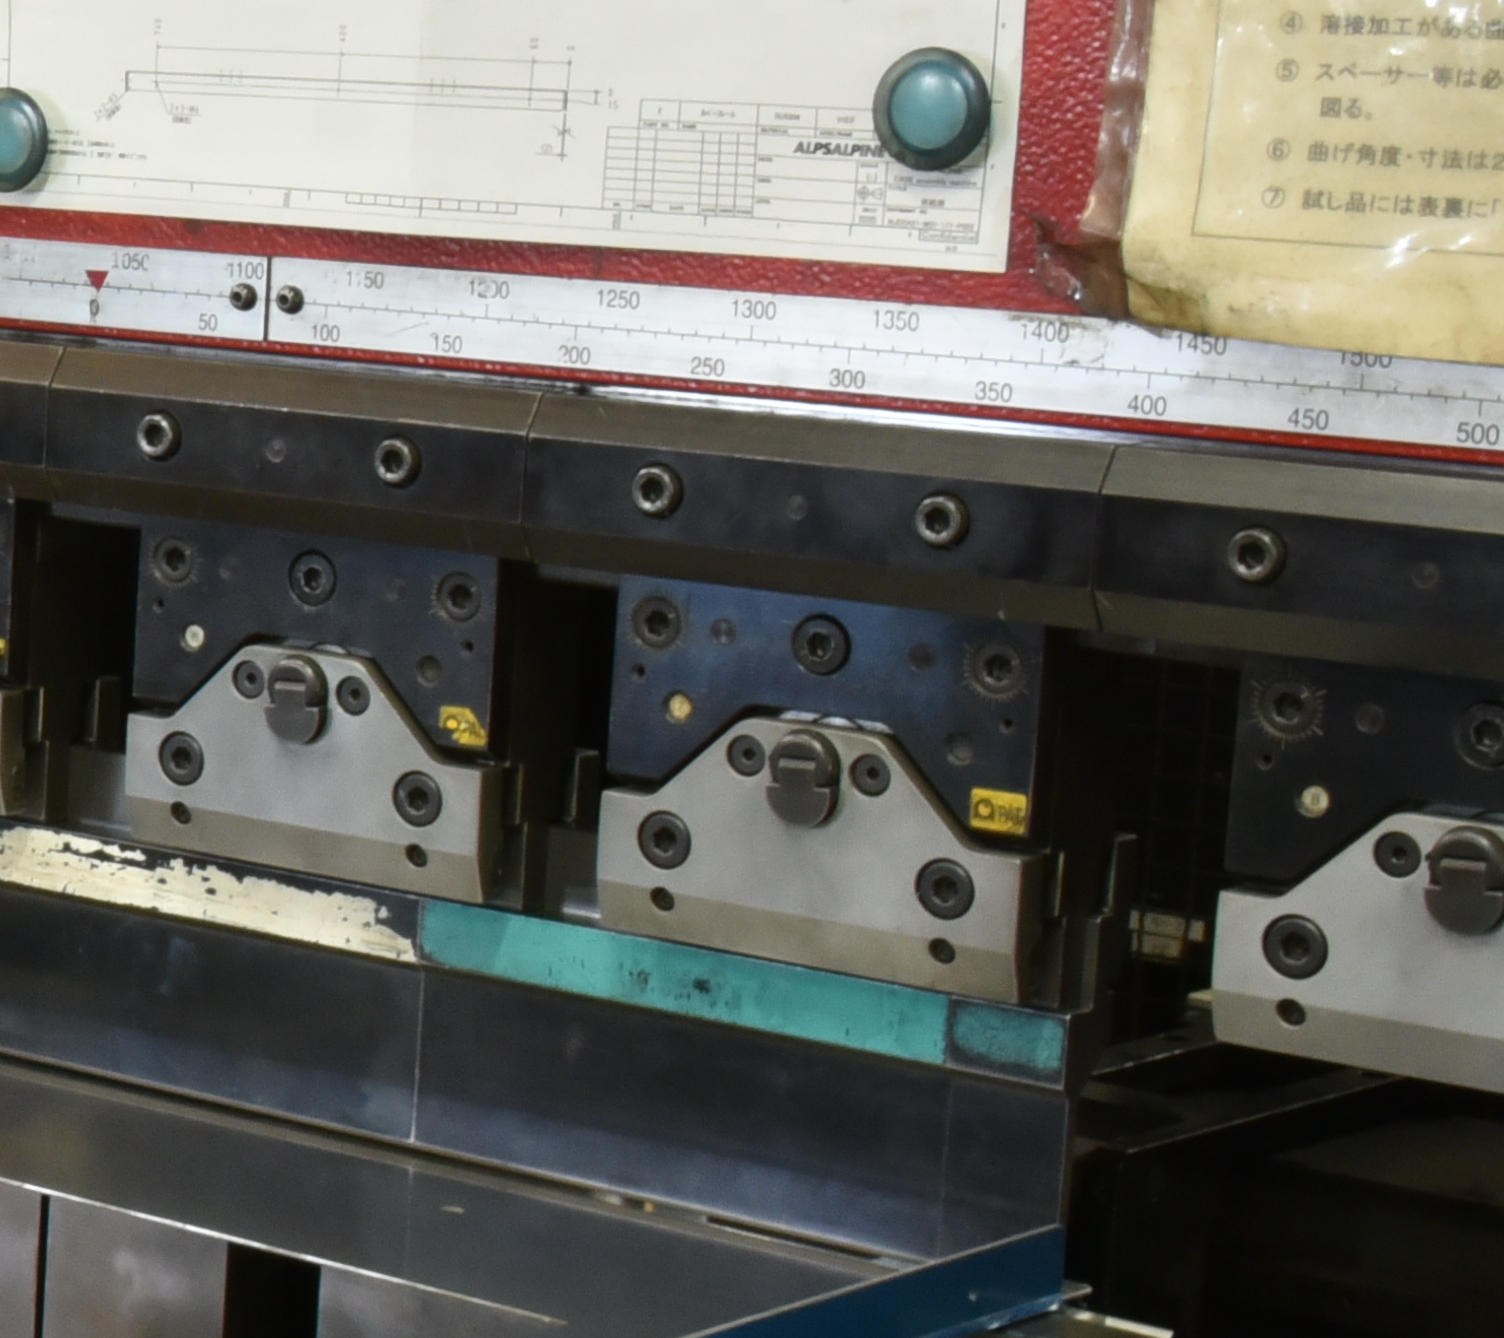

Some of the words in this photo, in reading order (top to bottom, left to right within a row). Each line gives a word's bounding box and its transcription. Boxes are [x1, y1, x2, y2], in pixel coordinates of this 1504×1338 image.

[1261, 185, 1286, 209] ⑦
[226, 259, 266, 281] 1100
[468, 279, 511, 301] 1200
[596, 288, 641, 311] 1250
[731, 298, 778, 321] 1300
[872, 308, 921, 333] 1350
[1020, 321, 1071, 344] 1400
[1175, 332, 1228, 357] 1450
[89, 298, 100, 317] 0
[198, 313, 219, 333] 50
[311, 323, 341, 344] 100
[432, 334, 464, 355] 150
[558, 344, 592, 365] 200
[690, 355, 726, 378] 250
[829, 367, 866, 390] 300
[974, 381, 1013, 404] 350
[1127, 394, 1168, 417] 400
[1287, 408, 1331, 431] 450
[1455, 422, 1502, 447] 500
